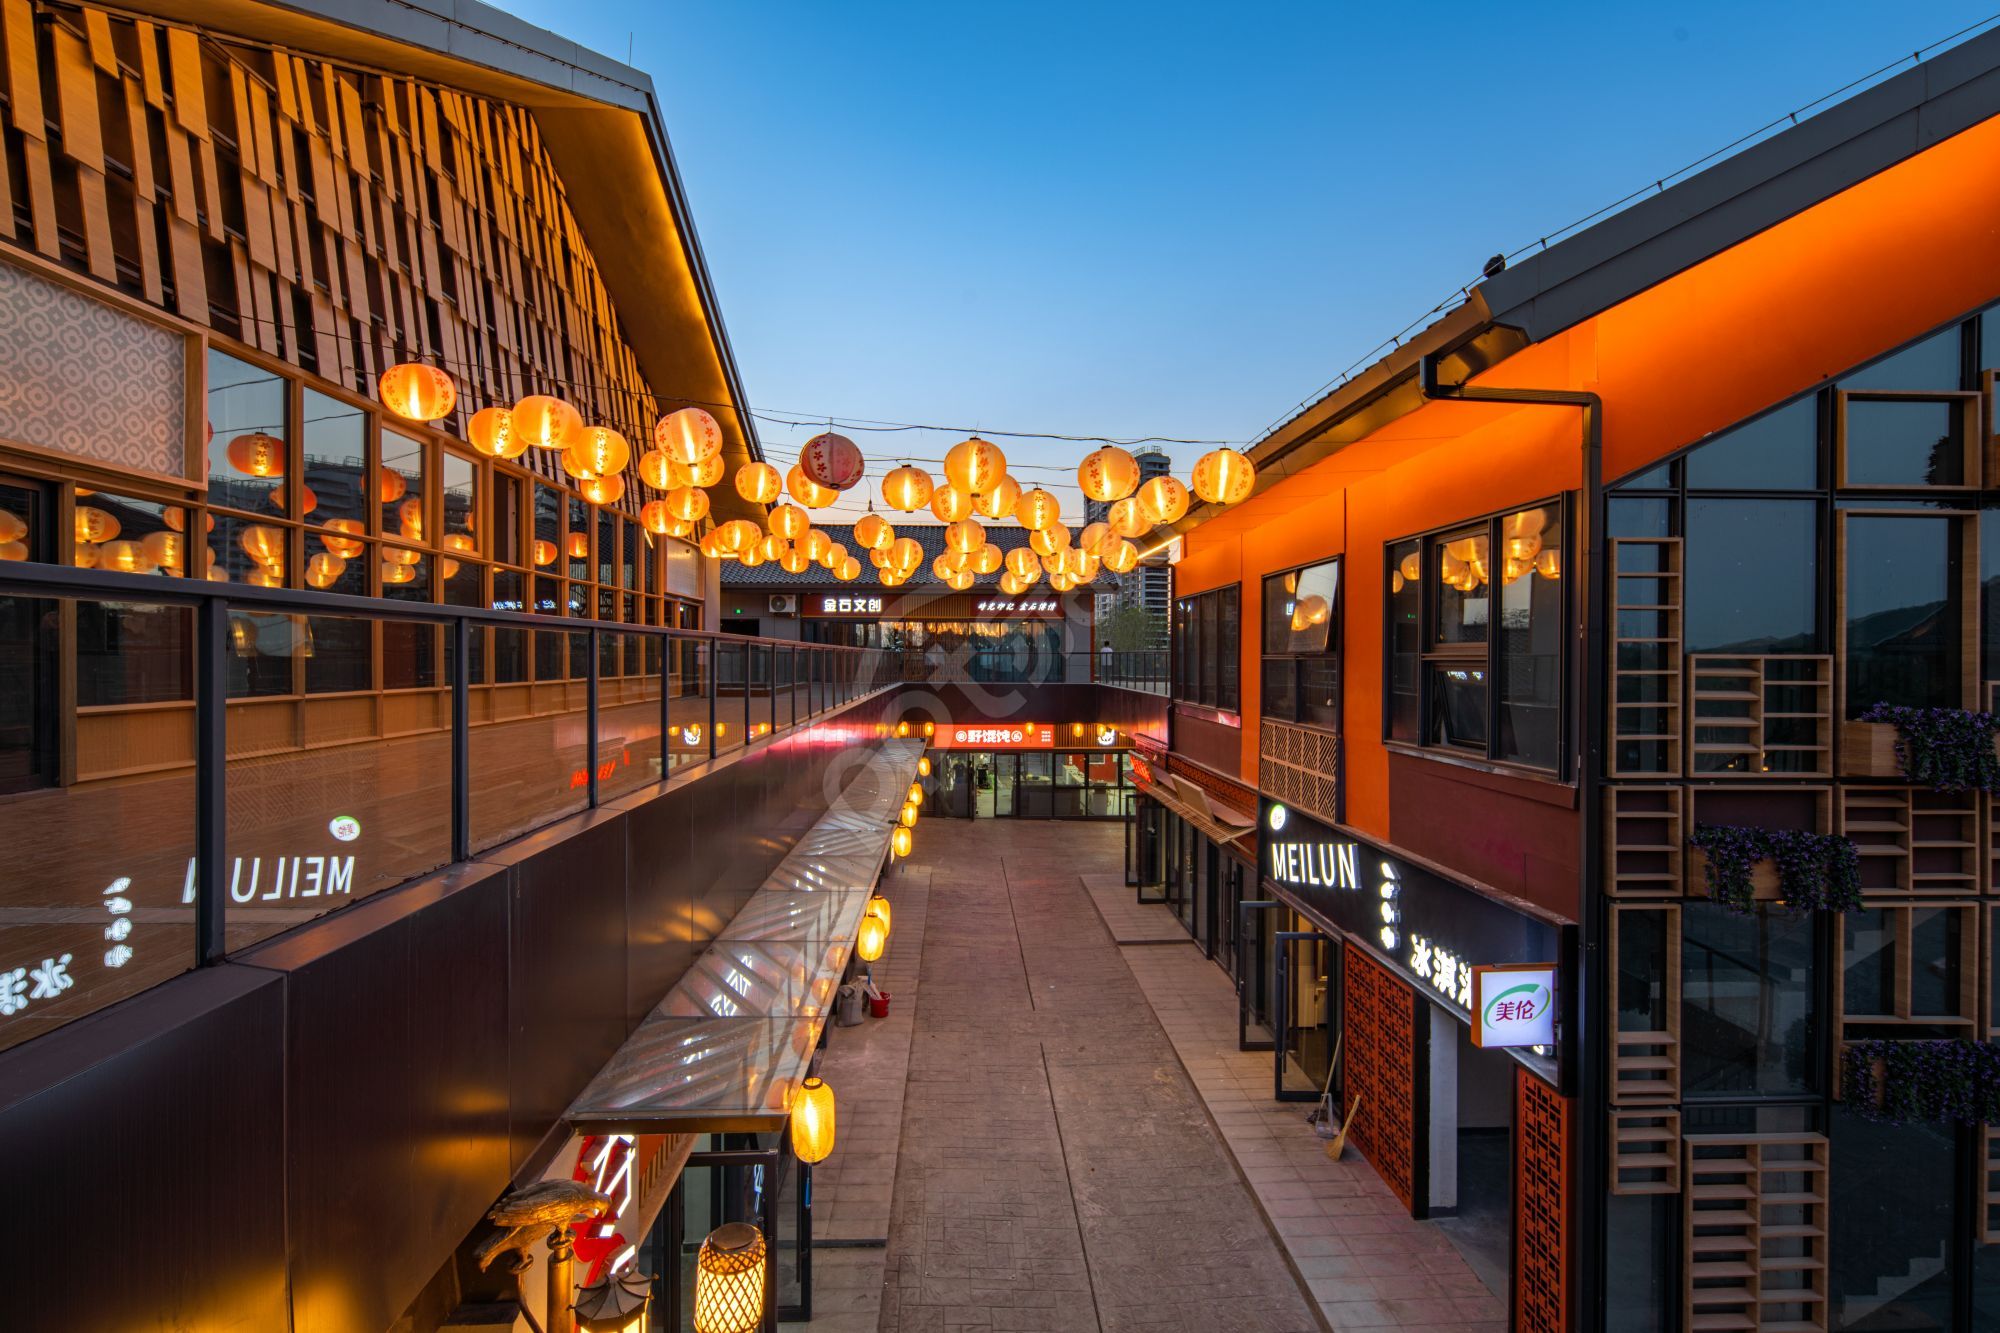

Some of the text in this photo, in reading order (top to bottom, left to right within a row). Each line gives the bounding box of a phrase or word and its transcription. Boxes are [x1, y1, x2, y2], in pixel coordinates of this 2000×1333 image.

[824, 599, 881, 612] 金石文创
[1272, 843, 1356, 889] MEILUN
[1495, 999, 1536, 1021] 美伦
